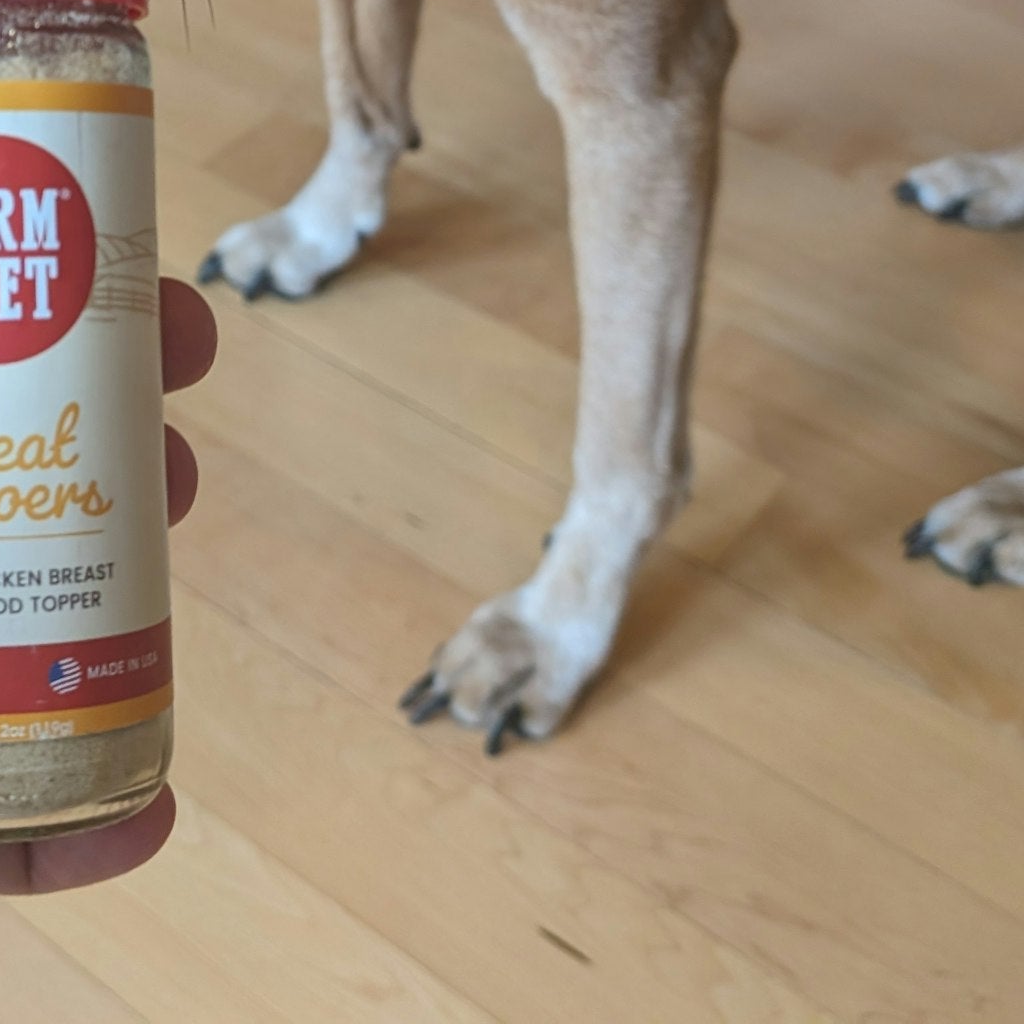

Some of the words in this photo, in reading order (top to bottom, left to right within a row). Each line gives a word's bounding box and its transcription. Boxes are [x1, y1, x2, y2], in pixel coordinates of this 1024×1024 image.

[48, 562, 115, 586] BREAST
[31, 591, 102, 613] TOPPER
[86, 660, 125, 679] MADE
[127, 657, 141, 672] IN
